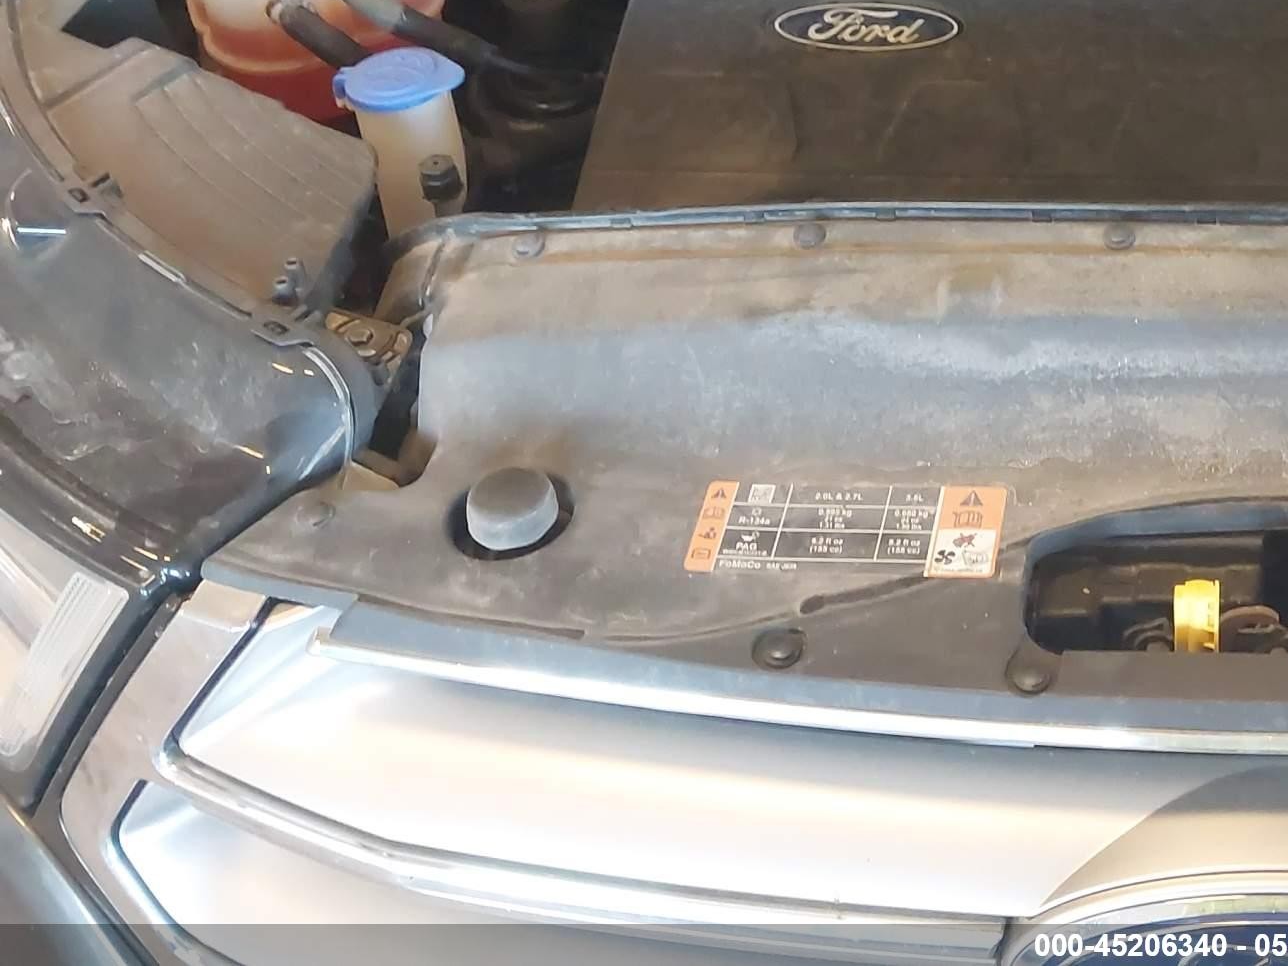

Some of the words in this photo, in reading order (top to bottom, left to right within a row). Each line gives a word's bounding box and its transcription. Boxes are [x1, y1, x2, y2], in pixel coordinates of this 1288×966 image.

[808, 8, 925, 44] Ford
[738, 516, 770, 525] R-134a
[736, 542, 758, 551] PAG
[719, 559, 761, 569] FoMoCo
